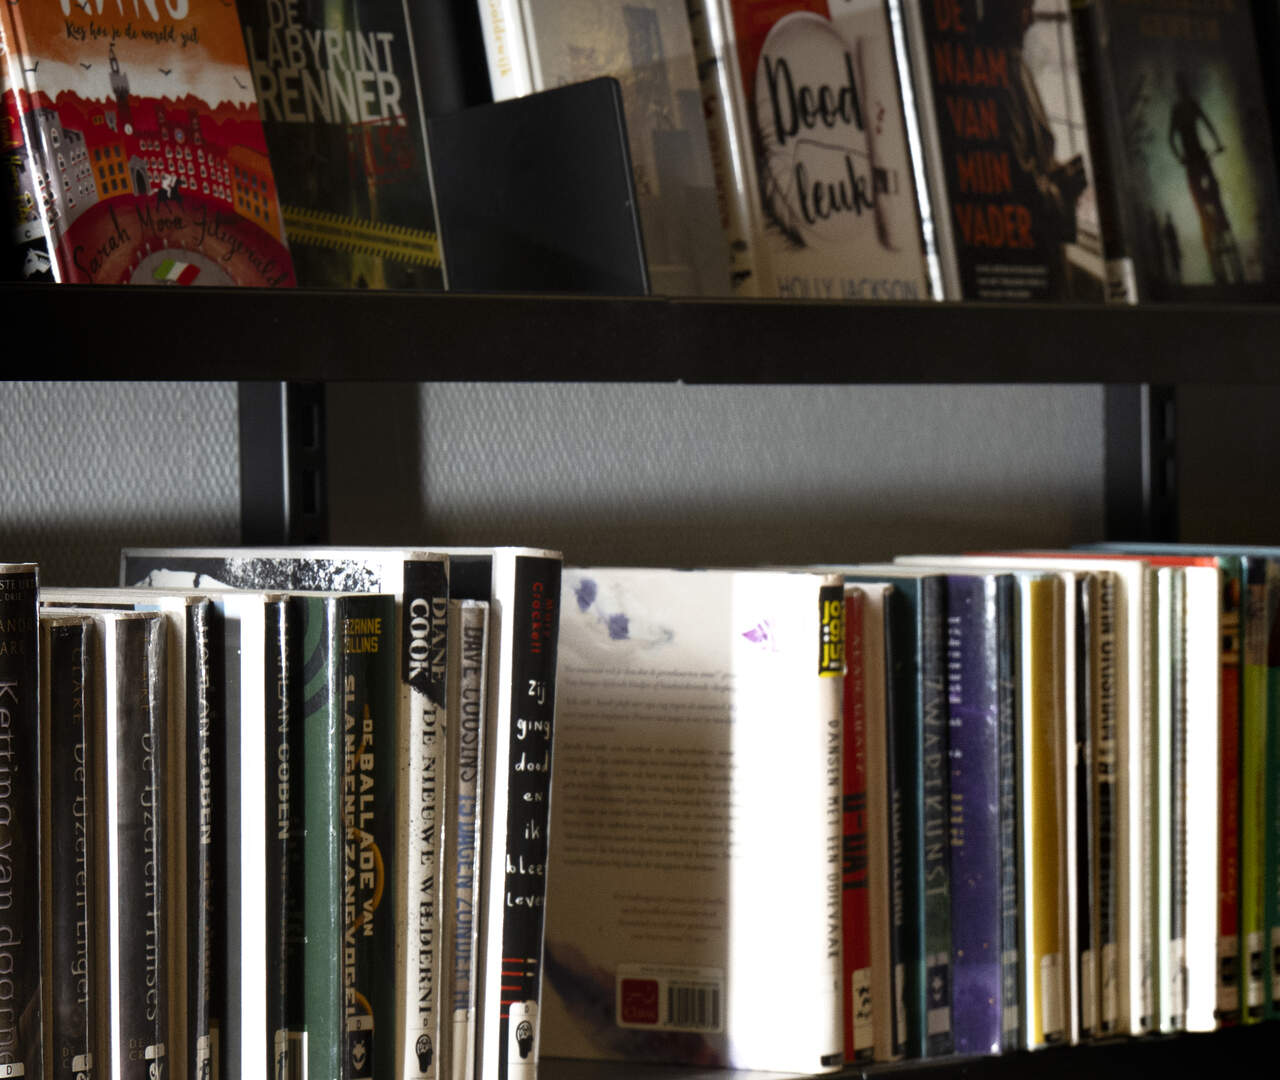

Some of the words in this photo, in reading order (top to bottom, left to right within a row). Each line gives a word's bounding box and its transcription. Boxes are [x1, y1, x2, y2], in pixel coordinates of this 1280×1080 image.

[66, 20, 86, 40] Kies
[89, 21, 107, 41] hoe
[111, 24, 123, 41] je
[125, 22, 138, 40] de
[246, 26, 394, 74] LABYRINT
[254, 64, 408, 127] RENNER
[763, 52, 865, 146] Dood
[947, 97, 1000, 140] VAN
[795, 155, 875, 225] leuk
[954, 203, 1034, 248] VADER
[73, 206, 131, 282] Sarah
[409, 598, 430, 681] COOK
[431, 597, 447, 684] DIANE
[463, 627, 482, 676] DAVE
[423, 707, 437, 745] DE
[527, 679, 546, 706] Zij
[0, 680, 19, 825] Ketting
[344, 674, 357, 809] SLANGEN
[461, 689, 481, 783] COUSINS
[514, 752, 548, 773] dood
[199, 746, 213, 845] COBEN
[277, 742, 291, 841] COBEN
[359, 752, 376, 890] BALLADE
[421, 756, 437, 865] NIEUWE
[344, 843, 357, 1017] ZANGVOGEL
[361, 903, 375, 937] VAN
[418, 875, 435, 1014] WILDERNI
[0, 911, 23, 1066] doorne
